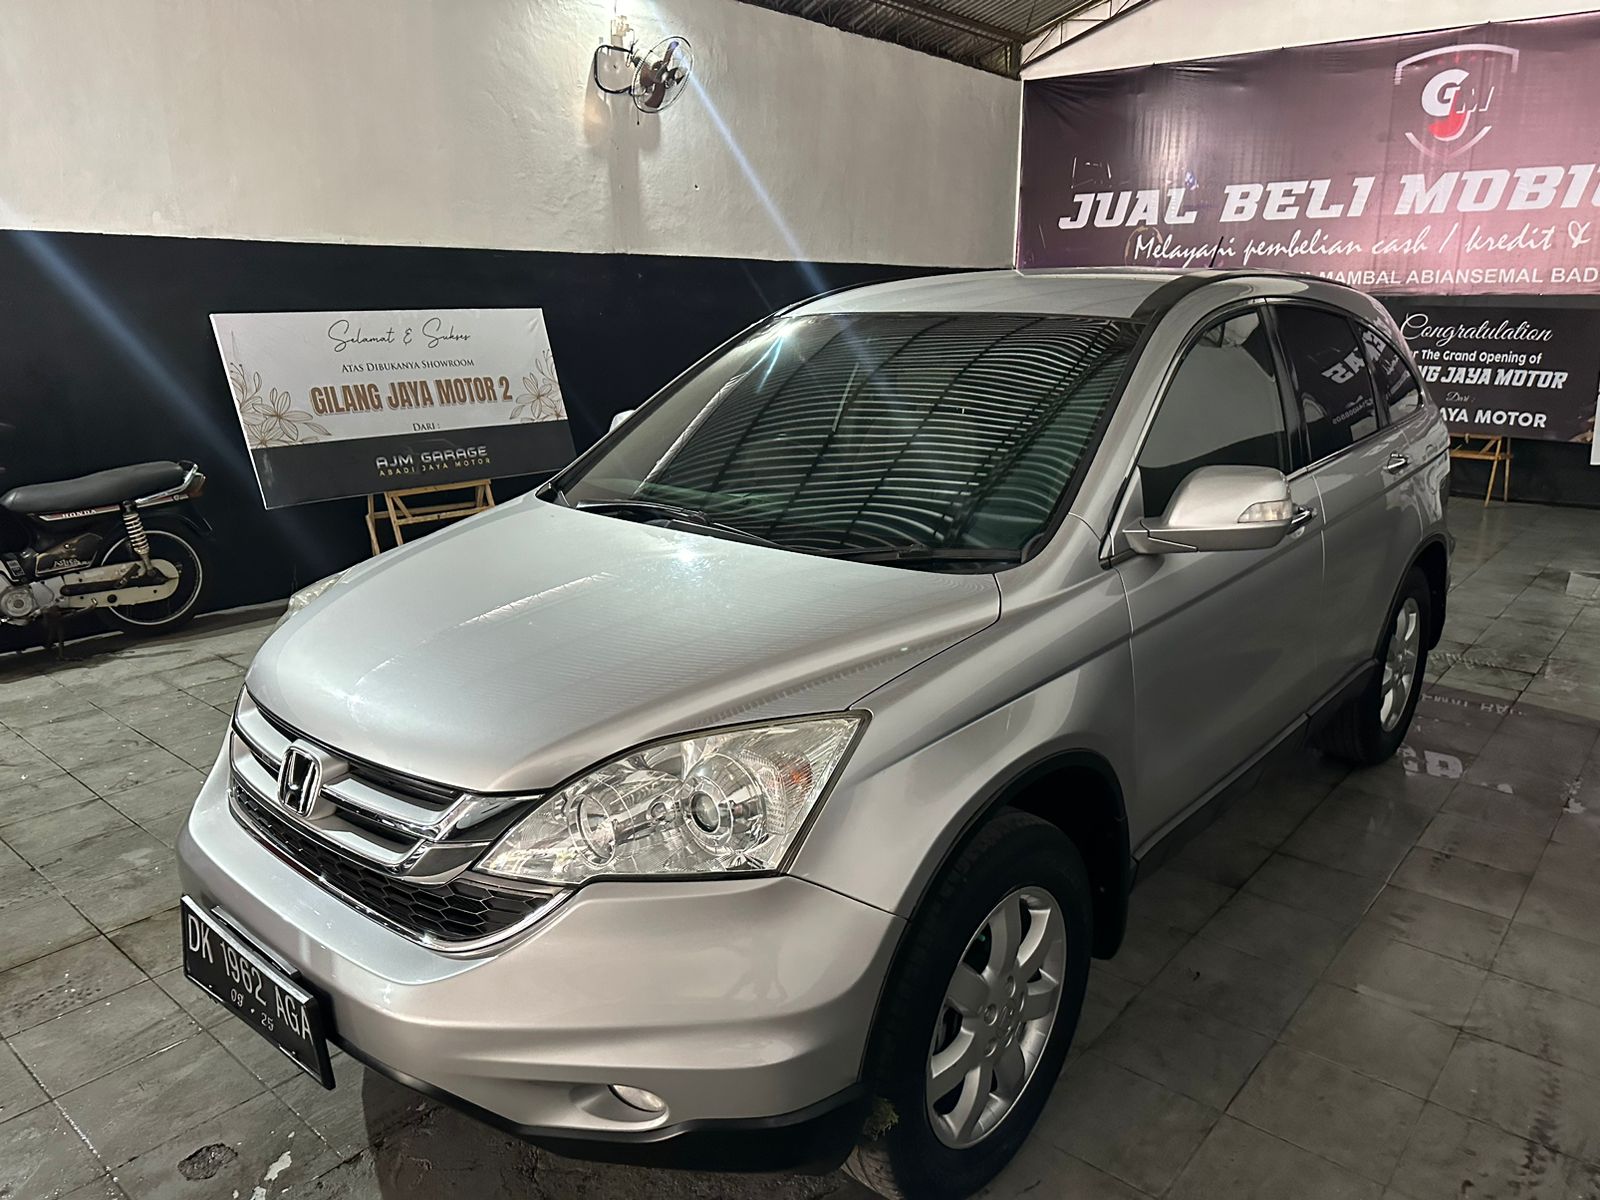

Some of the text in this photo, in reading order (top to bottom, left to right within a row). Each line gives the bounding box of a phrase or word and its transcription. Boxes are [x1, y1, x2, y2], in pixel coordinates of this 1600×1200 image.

[1058, 163, 1600, 230] JUAL BELI MOBI
[1243, 229, 1362, 266] pembelian
[1371, 224, 1428, 255] cash
[1439, 222, 1460, 254] /
[1465, 223, 1556, 255] kredit
[1568, 220, 1591, 249] &
[1405, 268, 1544, 285] ABIANSEMAL
[328, 319, 395, 352] Selamat
[422, 317, 471, 348] Sukses
[1400, 313, 1553, 347] Congratulation
[342, 363, 364, 373] ATAS
[421, 359, 475, 369] SHOWROOM
[1422, 349, 1440, 360] The
[1443, 350, 1477, 362] Grand
[1479, 351, 1526, 366] Opening
[1528, 352, 1543, 364] of
[1440, 366, 1492, 385] JAYA
[1494, 369, 1568, 389] MOTOR
[310, 376, 513, 416] GILANG JAYA MOTOR 2
[1474, 409, 1547, 428] MOTOR
[375, 446, 488, 469] AJM GARAGE
[379, 457, 491, 477] ABADI JAYA MOTOR
[62, 509, 97, 519] HONDA
[188, 914, 314, 1046] DK 1962 AGA
[261, 1012, 274, 1032] 25
